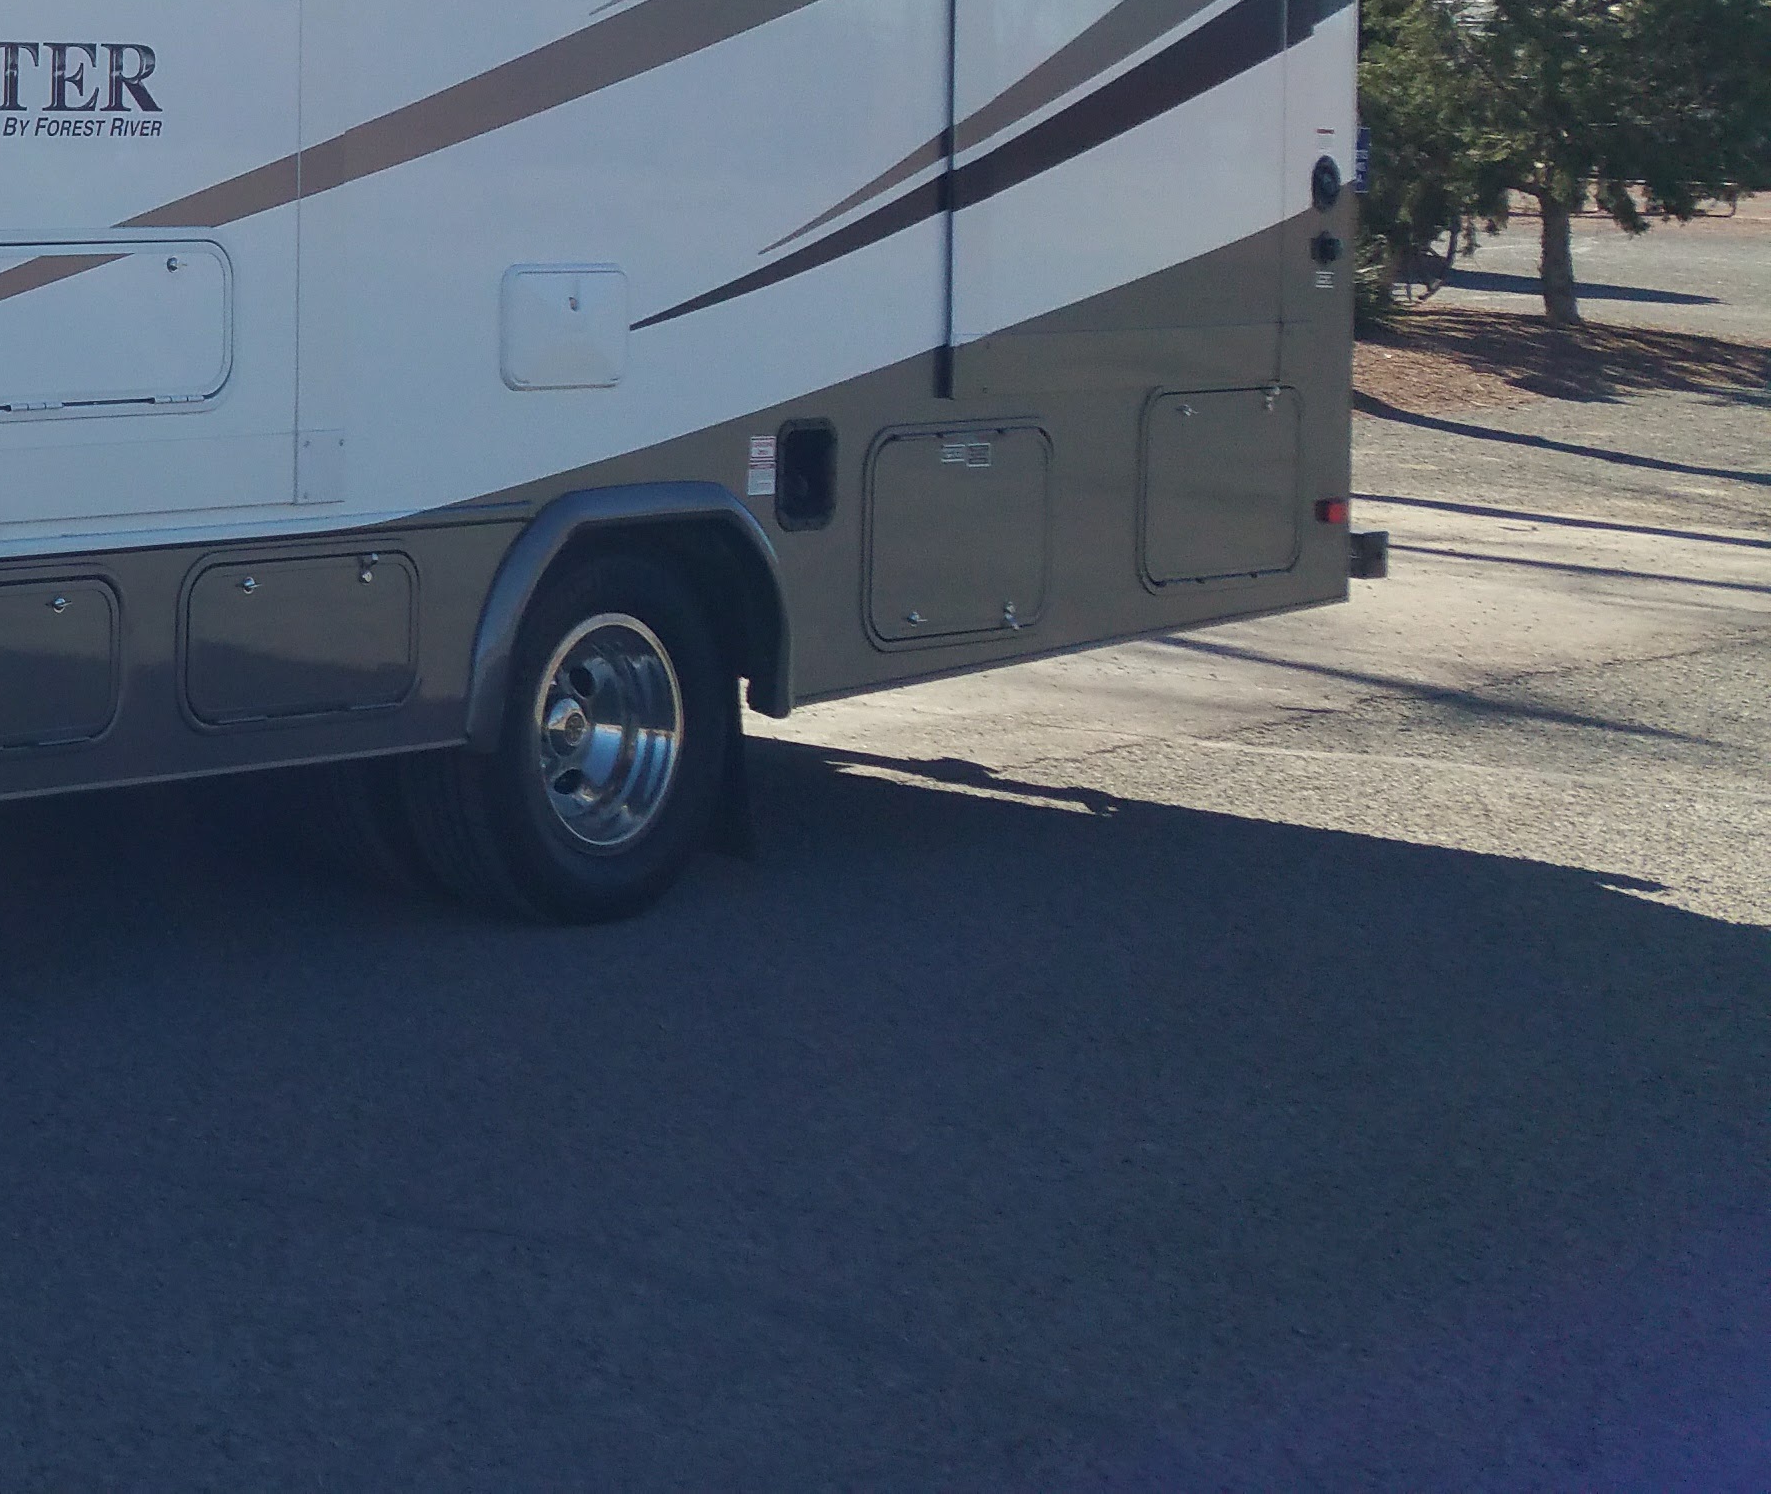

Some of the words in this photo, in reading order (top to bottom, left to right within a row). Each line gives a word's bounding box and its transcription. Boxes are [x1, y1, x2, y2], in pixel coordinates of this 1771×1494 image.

[2, 117, 30, 137] BY
[34, 117, 106, 137] FOREST
[110, 117, 162, 137] RIVER
